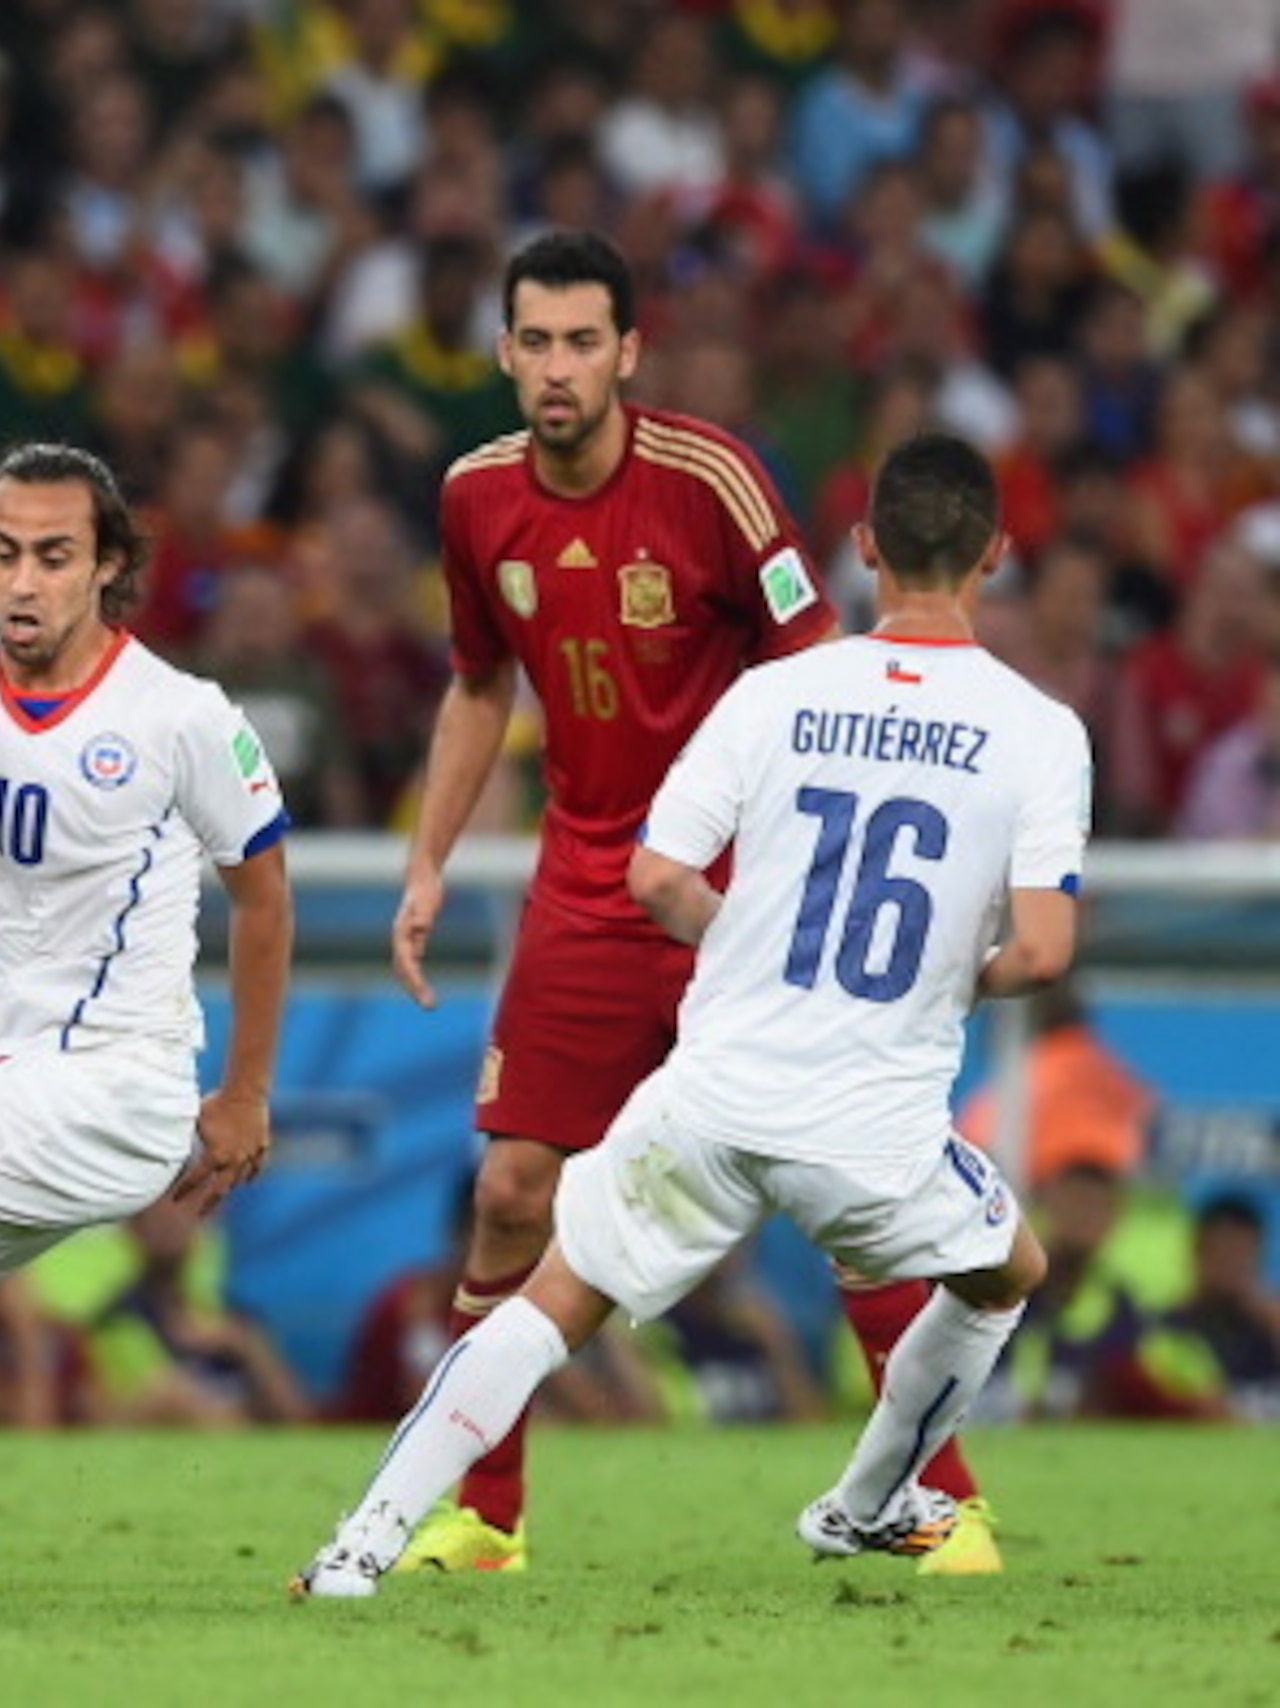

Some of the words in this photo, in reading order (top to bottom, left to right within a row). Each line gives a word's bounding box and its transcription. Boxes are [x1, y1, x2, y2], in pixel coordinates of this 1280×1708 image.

[561, 637, 617, 721] 16
[791, 704, 989, 774] GUTIÉRREZ
[783, 786, 950, 1004] 16
